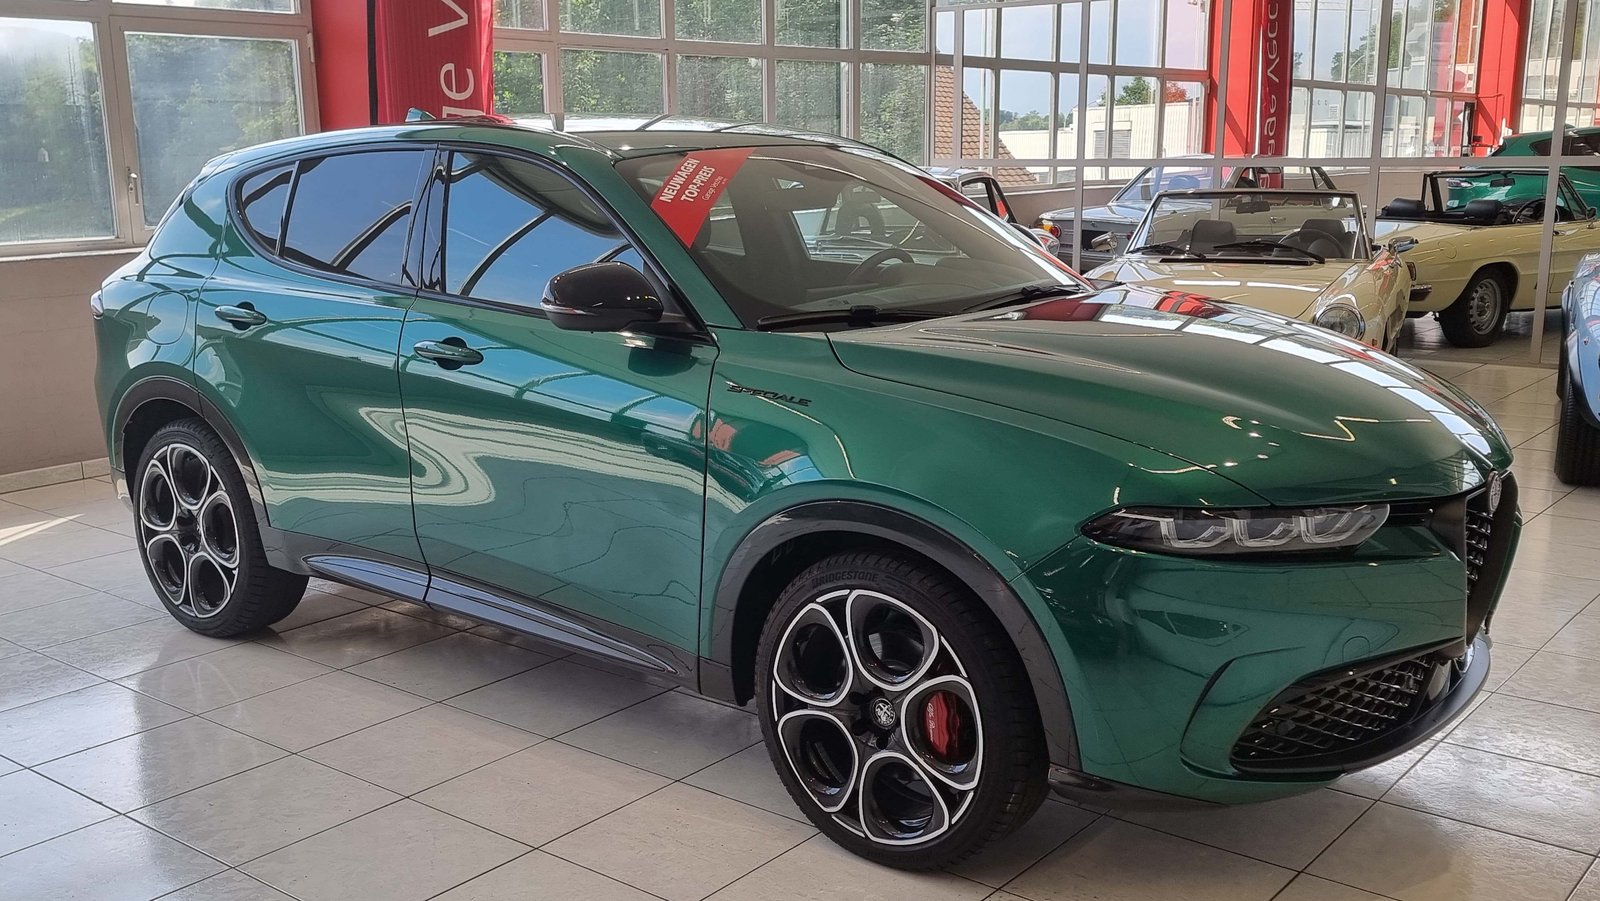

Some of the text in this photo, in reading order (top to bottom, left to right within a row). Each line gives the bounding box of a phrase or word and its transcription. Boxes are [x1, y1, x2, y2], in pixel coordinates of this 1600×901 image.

[659, 158, 700, 202] NEUWAGEN
[680, 165, 715, 202] TOP-PREIS
[727, 385, 812, 407] SPECIALE
[812, 570, 879, 588] BRIDGESTONE
